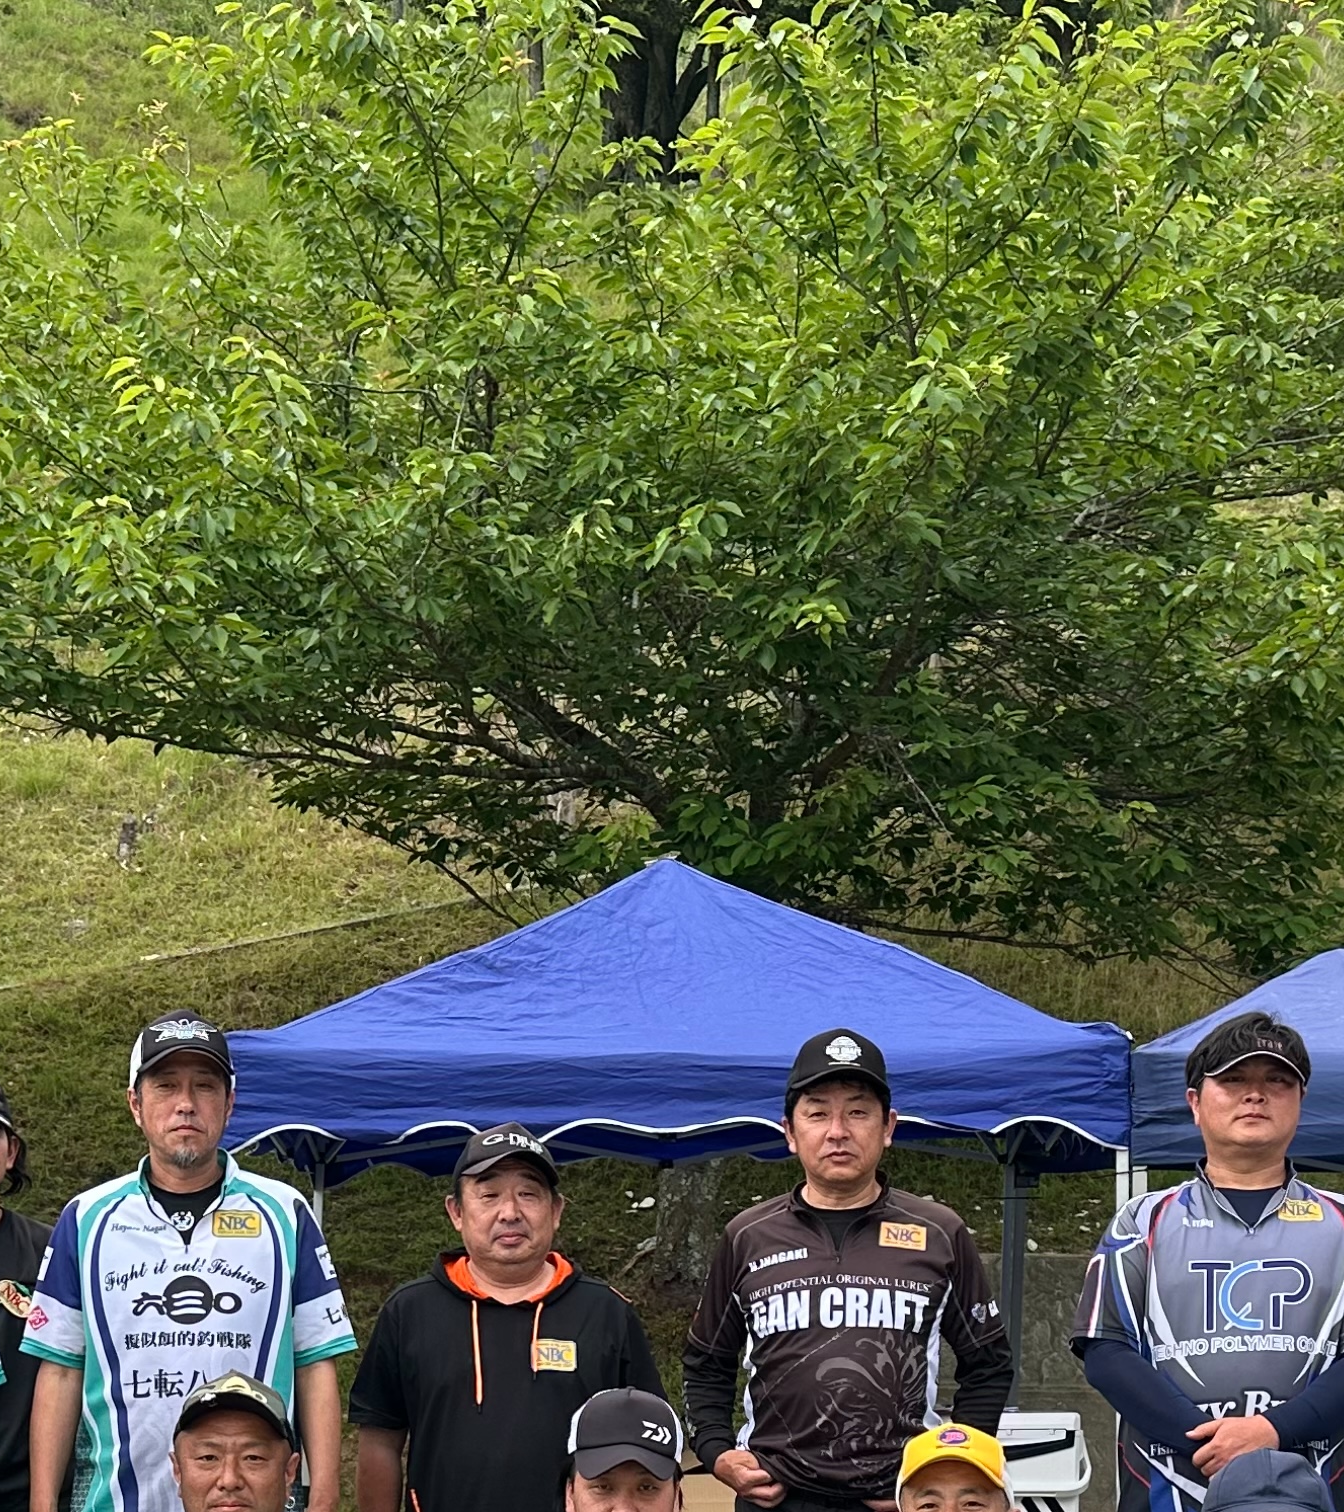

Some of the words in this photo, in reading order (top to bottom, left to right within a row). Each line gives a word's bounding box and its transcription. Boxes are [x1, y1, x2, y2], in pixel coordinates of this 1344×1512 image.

[1282, 1201, 1319, 1216] NBC
[218, 1216, 257, 1230] NBC
[885, 1228, 921, 1243] NBC
[105, 1263, 148, 1291] Fight
[153, 1258, 168, 1274] it
[174, 1257, 204, 1272] out!
[207, 1258, 269, 1293] Fishing
[773, 1275, 833, 1292] POTENTIAL
[835, 1274, 891, 1286] ORIGINAL
[895, 1279, 931, 1293] LURES
[2, 1284, 30, 1316] NBC
[1188, 1259, 1313, 1333] TCP
[750, 1290, 811, 1339] GAN
[819, 1286, 930, 1333] CRAFT
[1211, 1335, 1294, 1353] POLYMER
[537, 1347, 572, 1362] NBC
